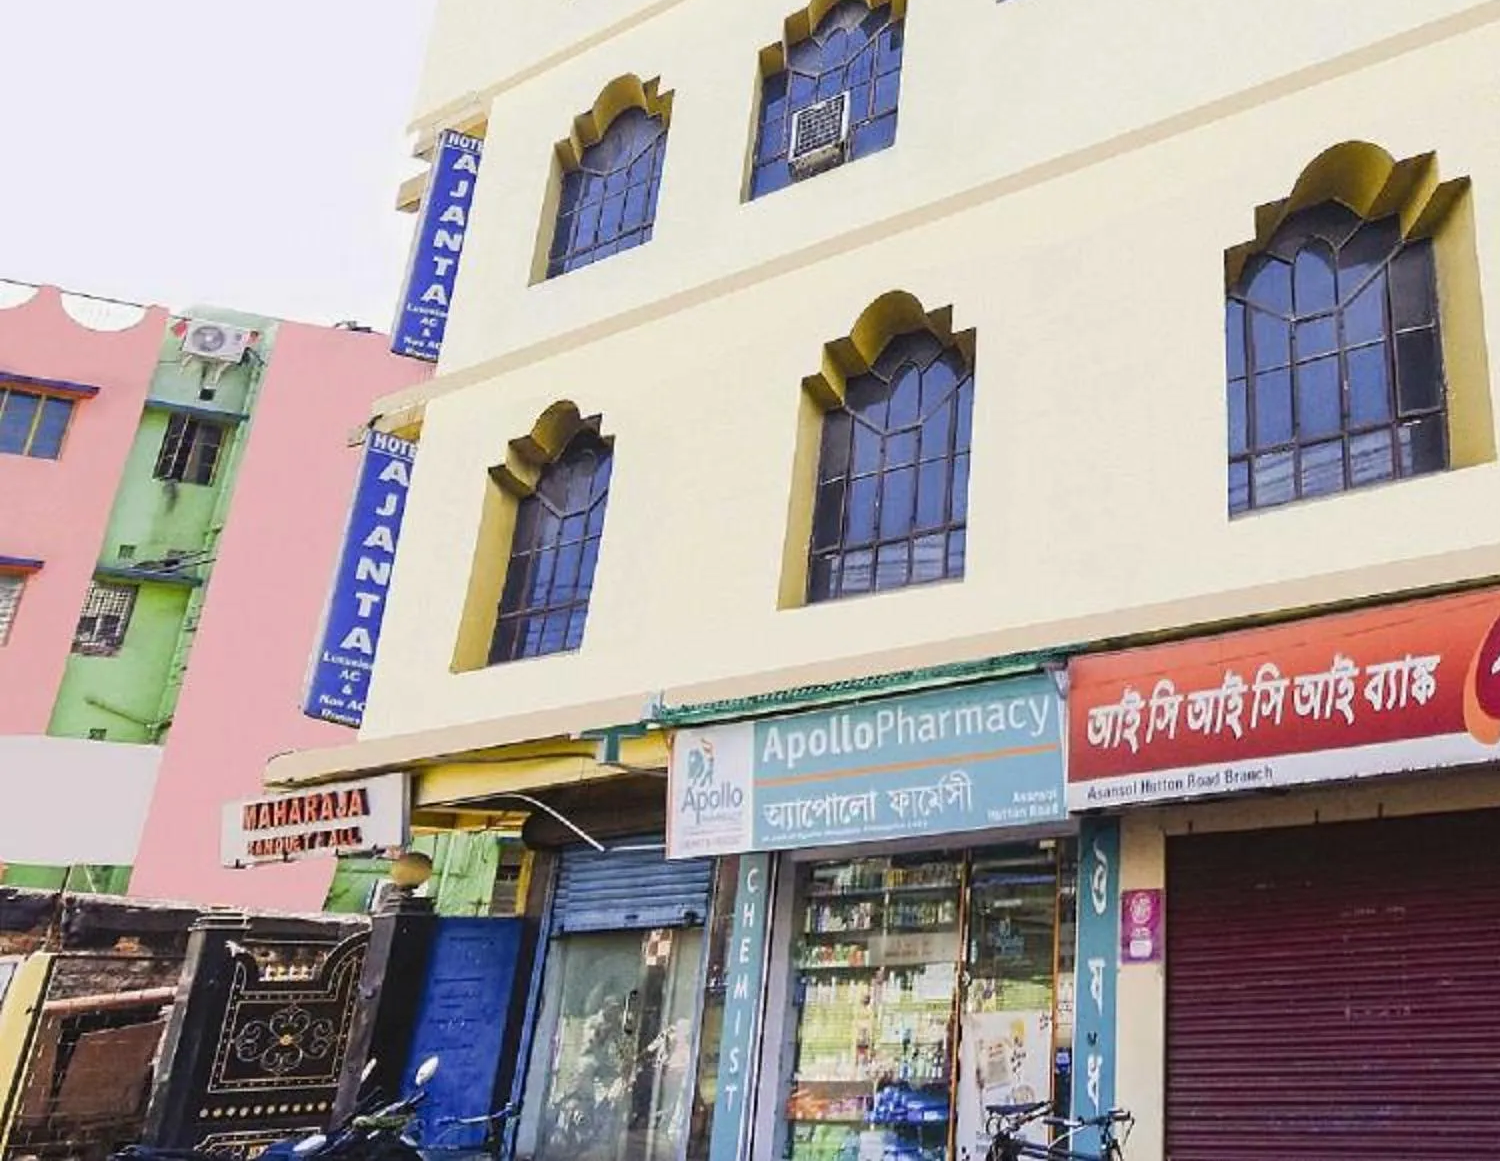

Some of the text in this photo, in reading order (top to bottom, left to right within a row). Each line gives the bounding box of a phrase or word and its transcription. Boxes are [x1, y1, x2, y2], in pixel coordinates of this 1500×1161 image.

[420, 153, 479, 306] AJANTA
[338, 459, 409, 654] AJANTA
[1087, 685, 1145, 753] আই
[1145, 678, 1184, 744] সি
[1187, 669, 1248, 739] আই
[1250, 662, 1290, 729] সি
[1293, 652, 1359, 725] আই
[243, 788, 368, 831] MAHARAJA
[681, 780, 744, 824] Apollo
[1087, 766, 1274, 801] Asansol Hutton Road Branch
[724, 868, 760, 1113] CHEMIST
